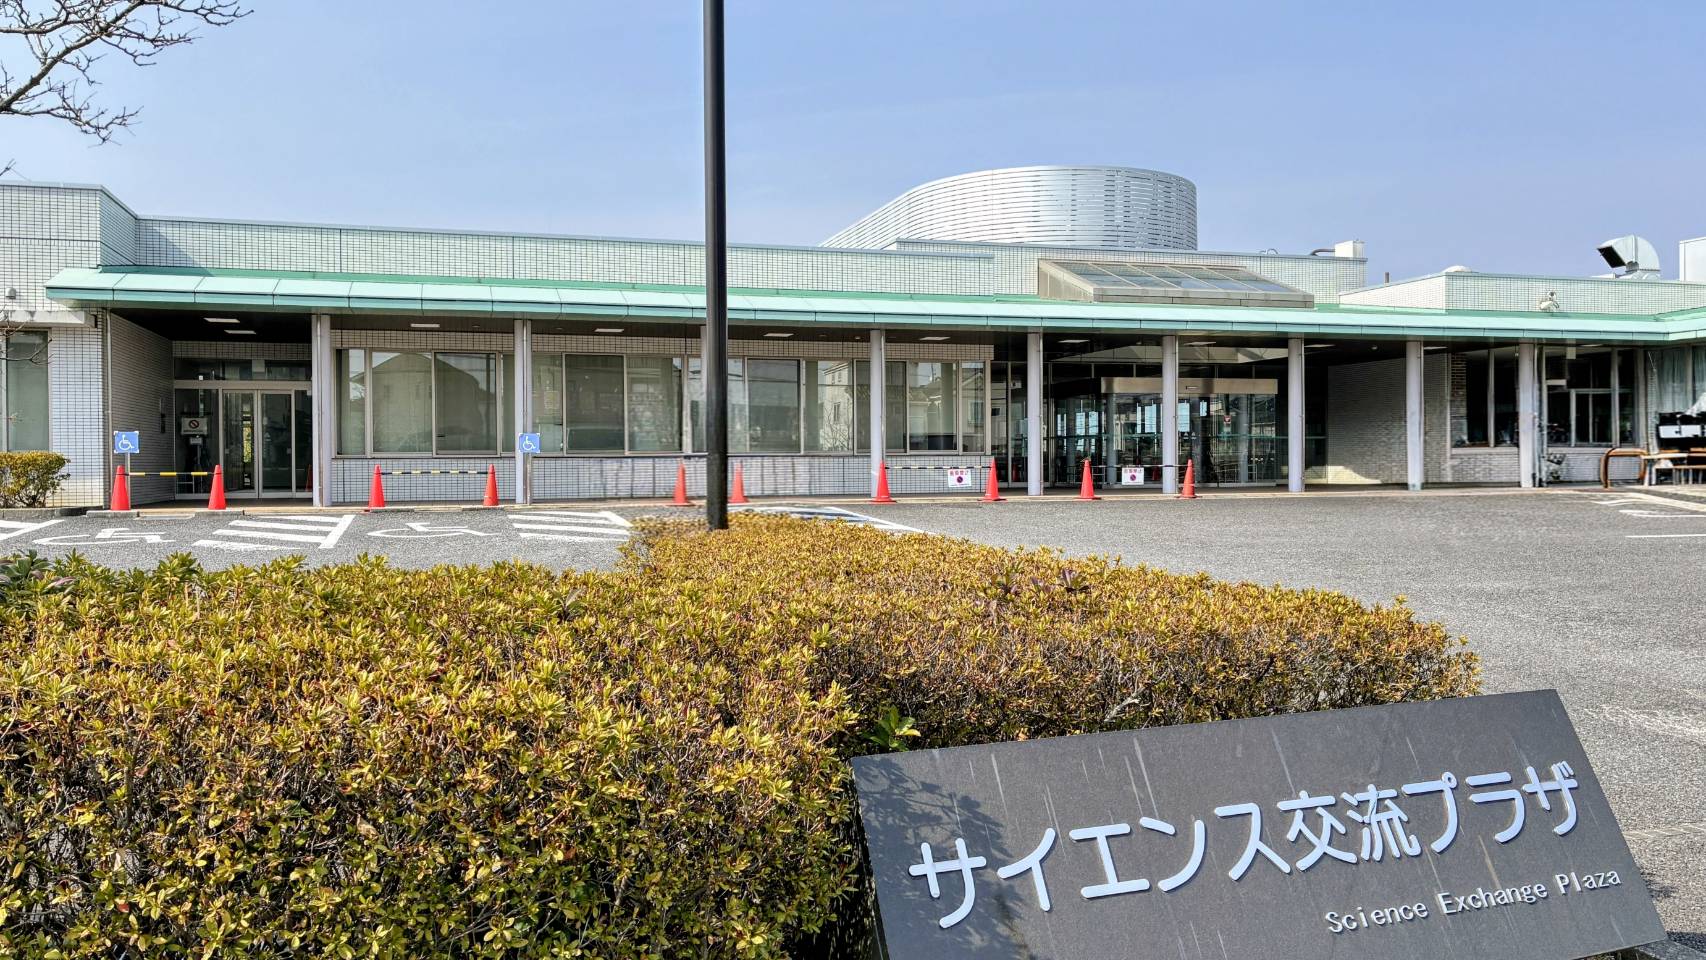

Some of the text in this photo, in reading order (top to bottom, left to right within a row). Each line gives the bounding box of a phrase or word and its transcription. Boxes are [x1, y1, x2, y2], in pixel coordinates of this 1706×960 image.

[909, 761, 1578, 928] サイエンス交流プラザ
[1325, 870, 1621, 933] Science Exchange Plaza
